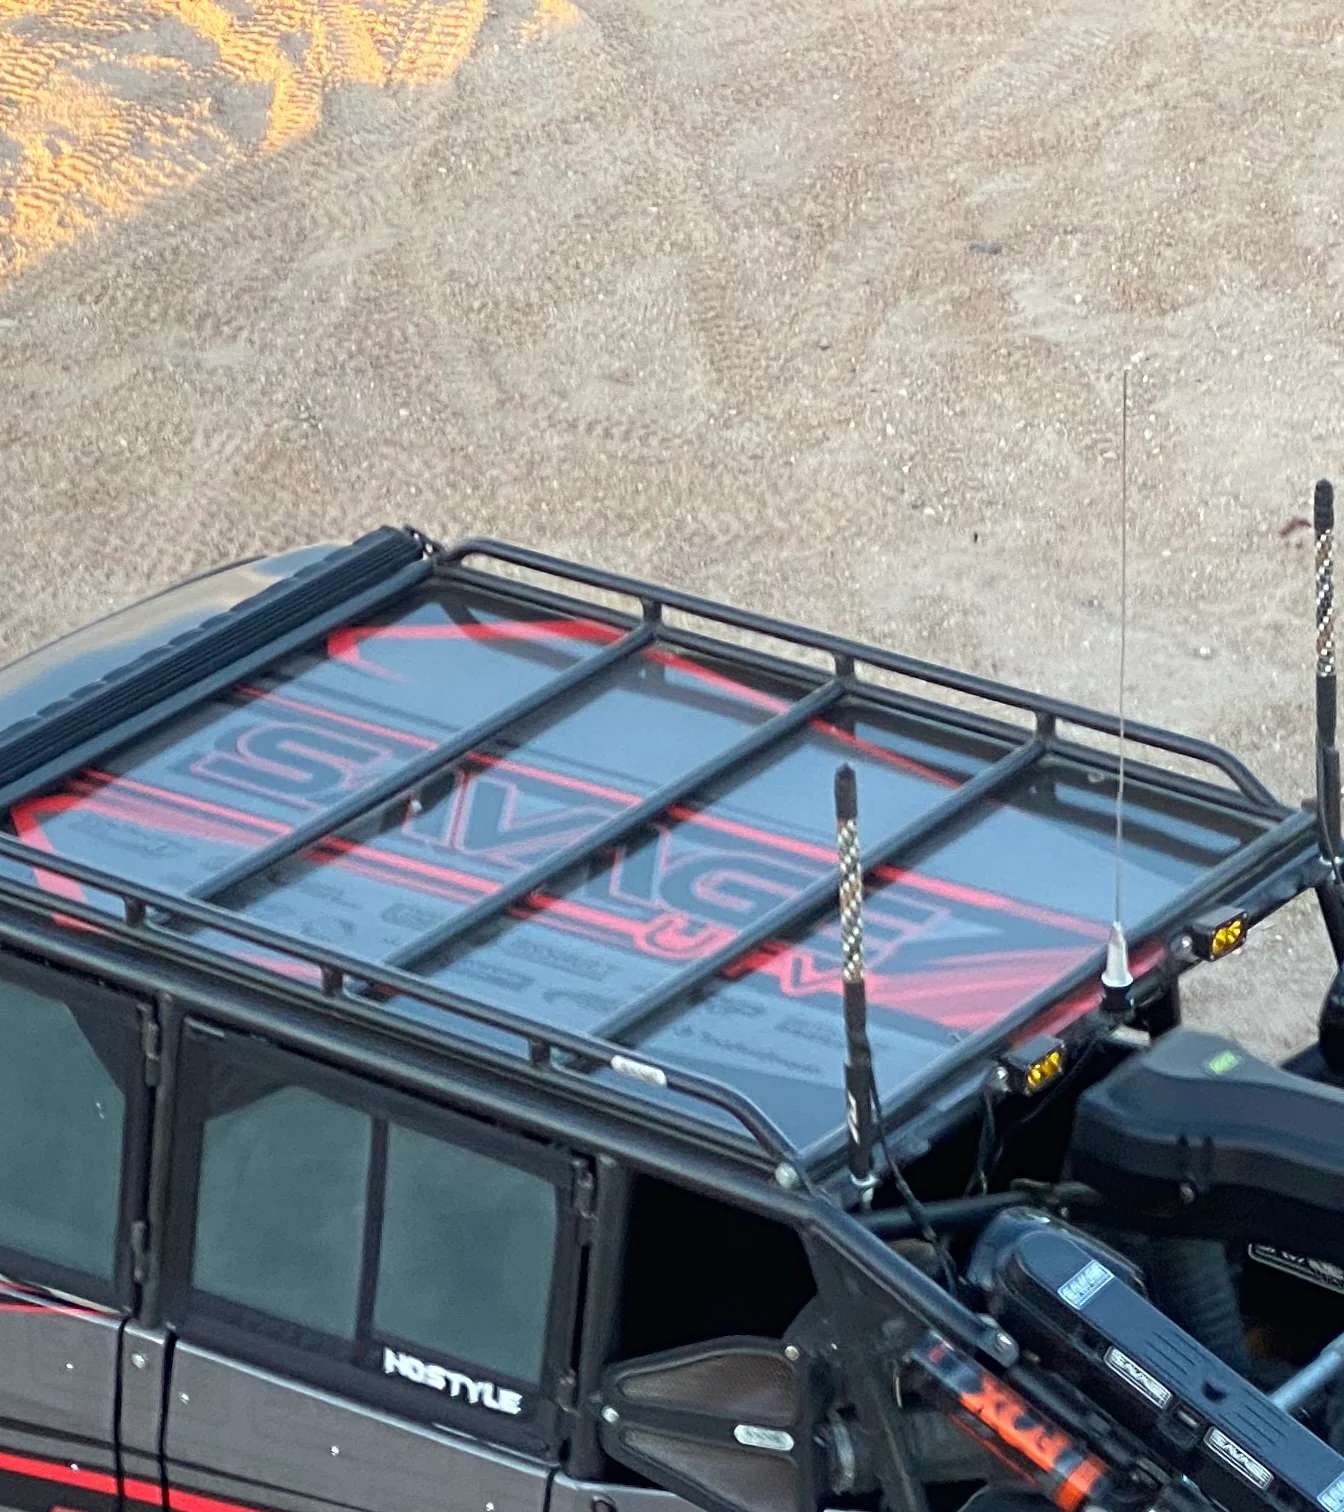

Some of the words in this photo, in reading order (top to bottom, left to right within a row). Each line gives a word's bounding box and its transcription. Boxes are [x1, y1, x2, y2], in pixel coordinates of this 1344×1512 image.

[188, 717, 953, 968] SVGE
[635, 913, 846, 997] UV
[384, 1347, 522, 1415] HOSTYLE
